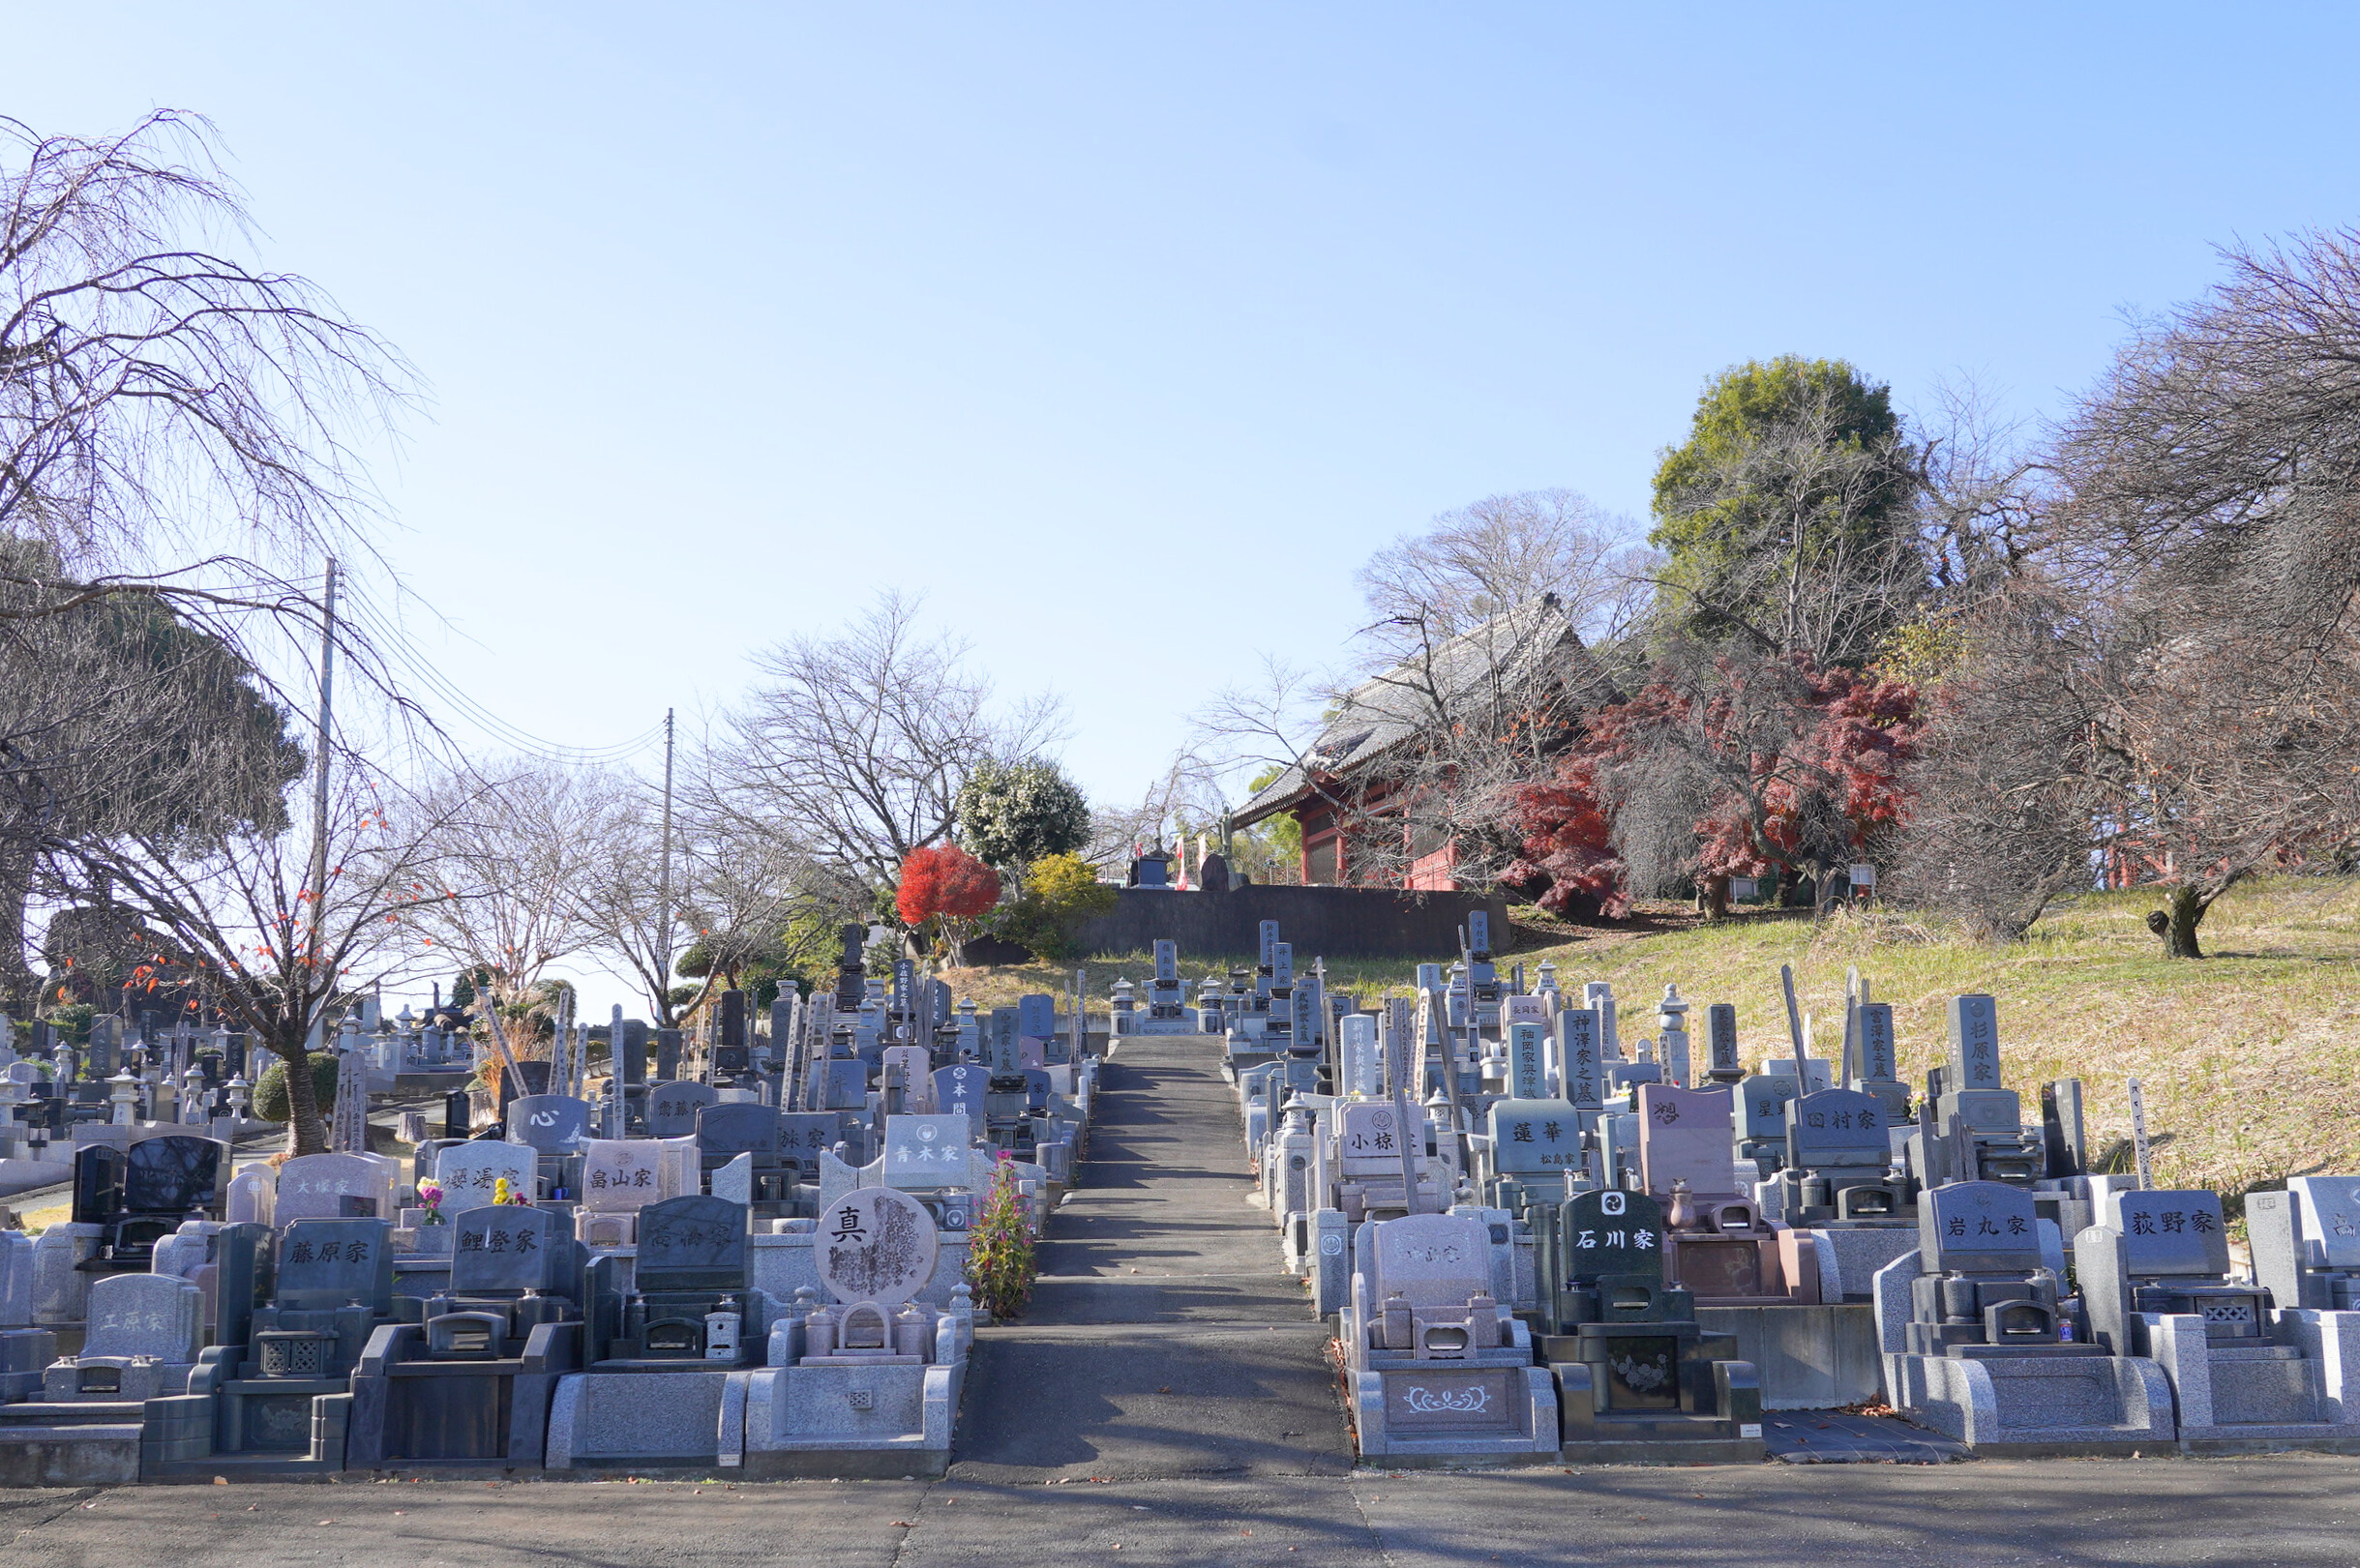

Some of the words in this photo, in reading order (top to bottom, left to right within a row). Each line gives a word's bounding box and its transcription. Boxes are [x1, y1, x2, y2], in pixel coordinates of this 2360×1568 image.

[1278, 946, 1288, 985] 井上家
[1511, 1005, 1539, 1015] 長岡家
[1572, 1014, 1597, 1103] 神澤家之墓
[1969, 1021, 1994, 1081] 杉原家
[529, 1109, 560, 1127] 心
[1807, 1109, 1876, 1130] 田村家
[895, 1145, 960, 1163] 青木家
[1540, 1152, 1575, 1166] 松島家
[296, 1179, 350, 1195] 大塚家
[590, 1169, 653, 1189] 畠山家
[830, 1205, 868, 1244] 真
[1947, 1215, 2028, 1237] 岩丸家
[1575, 1228, 1656, 1250] 石川家
[288, 1239, 371, 1263] 藤原家
